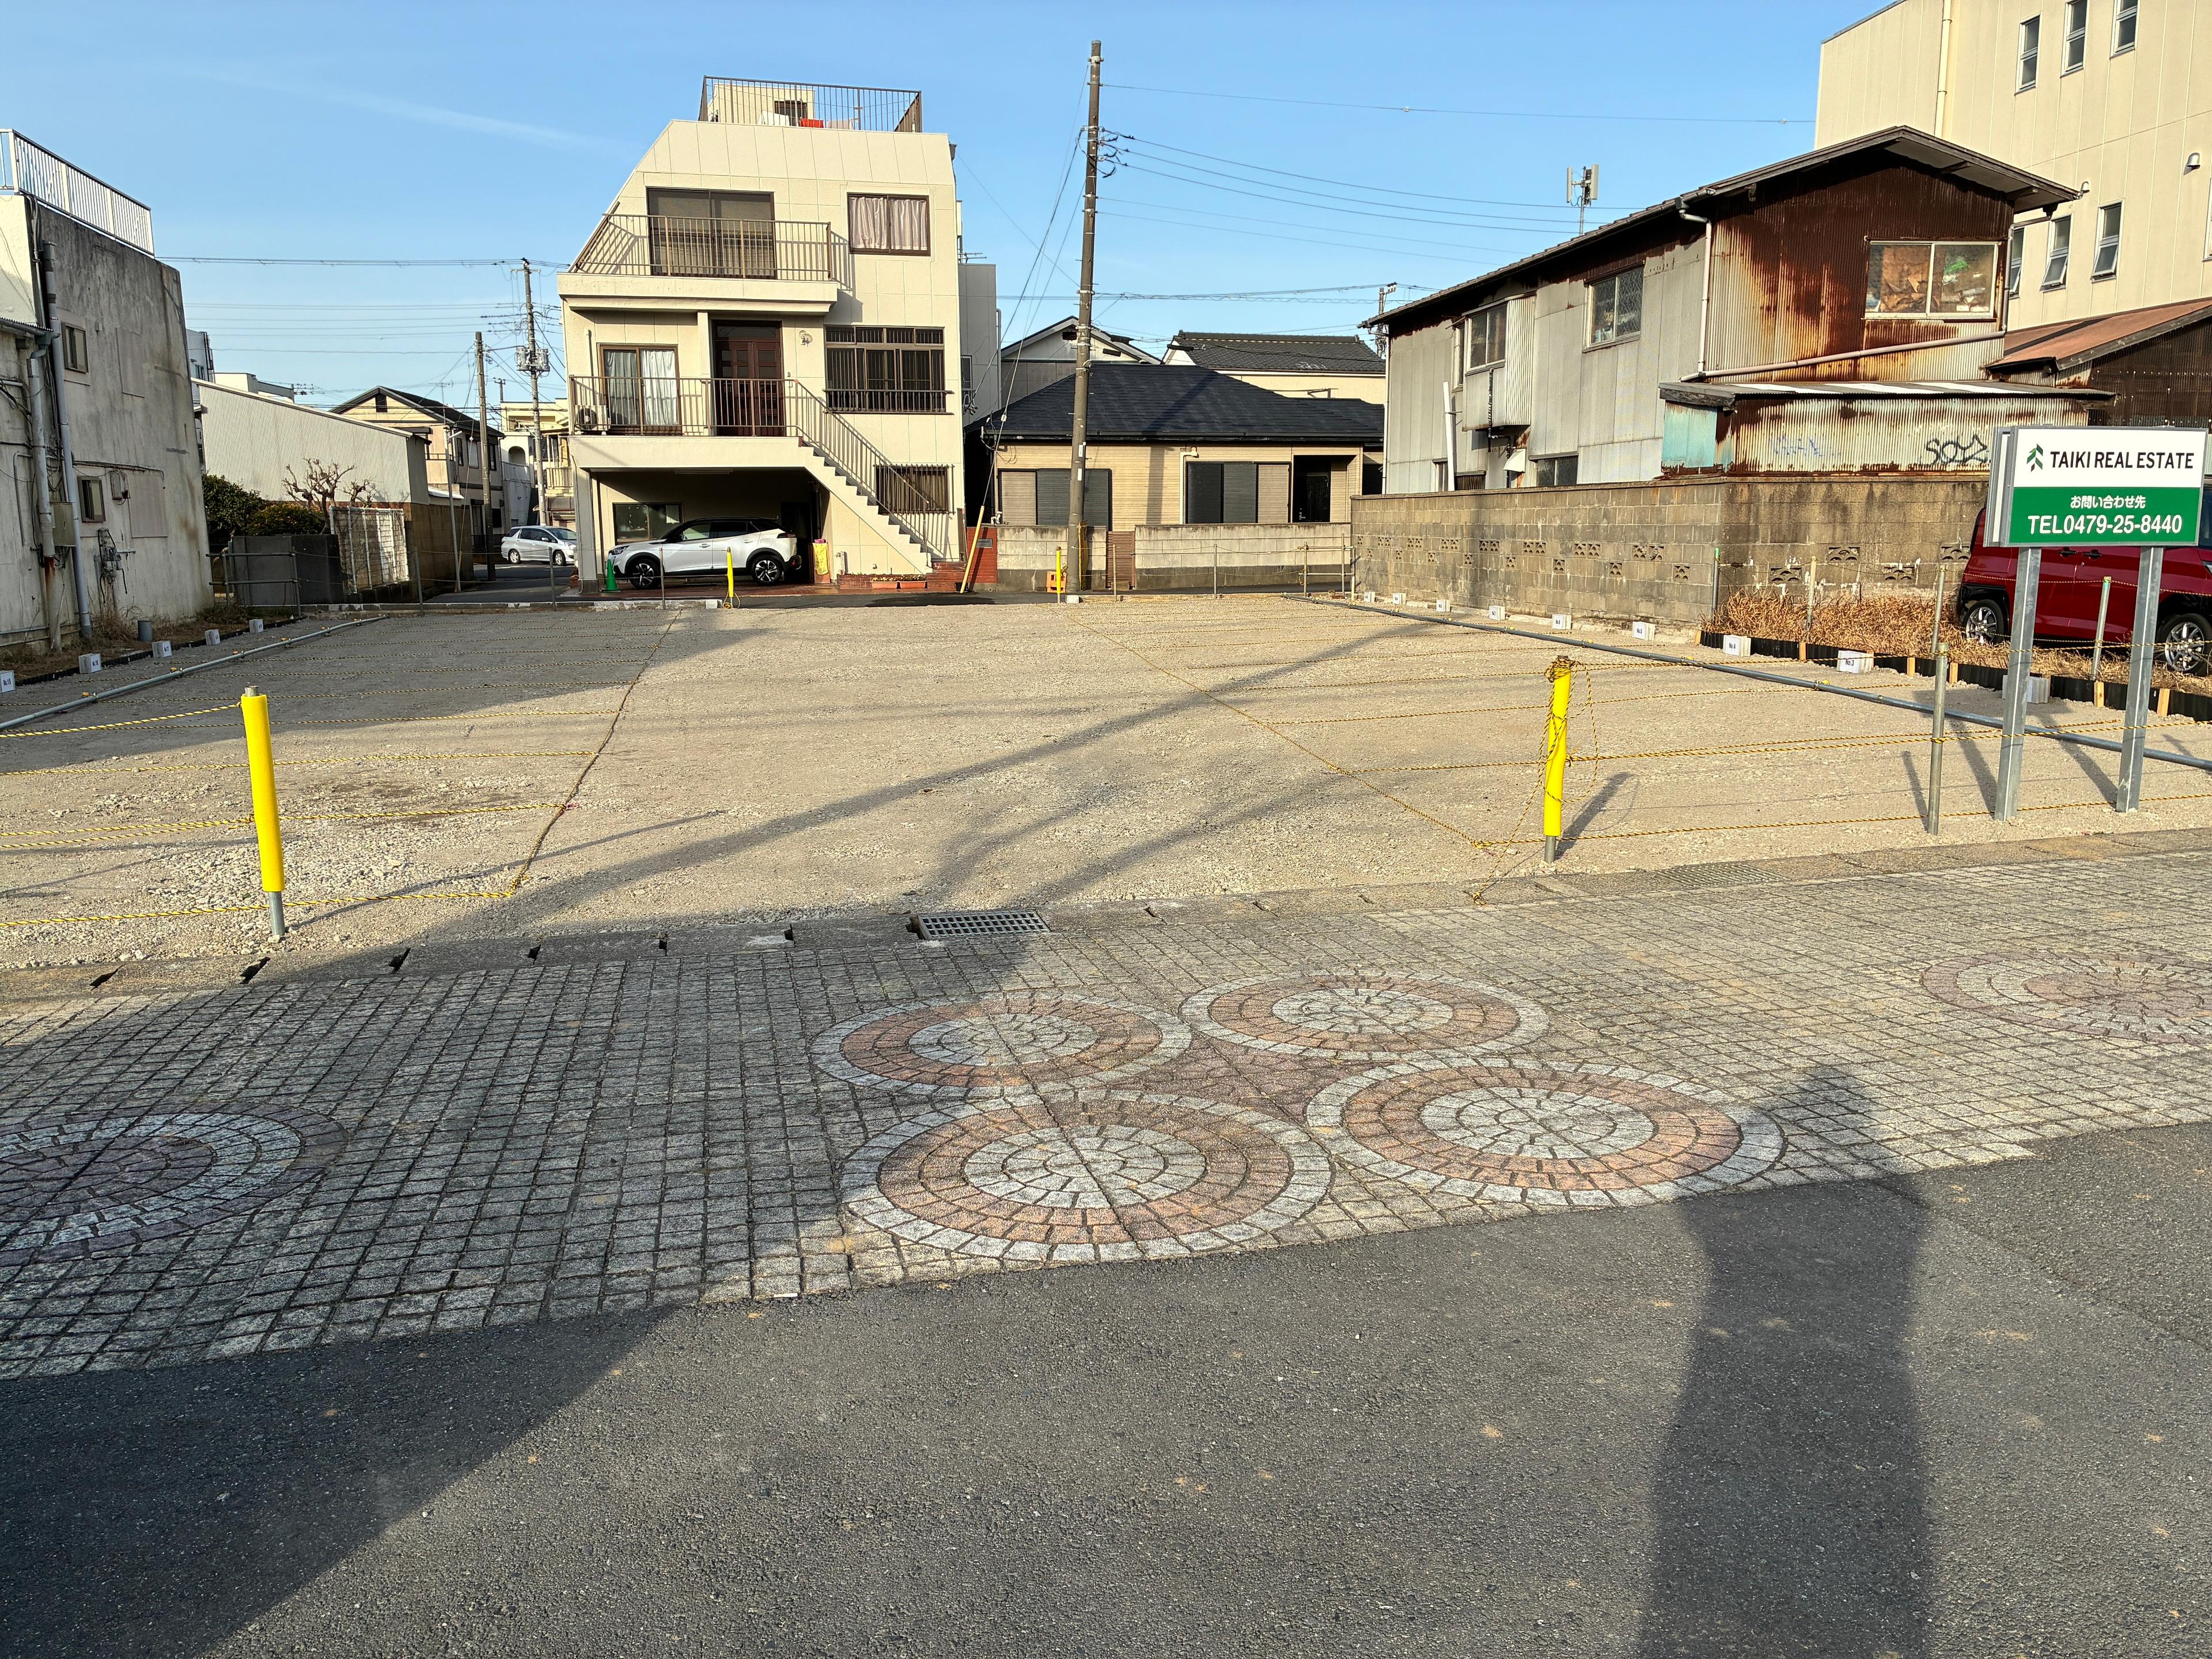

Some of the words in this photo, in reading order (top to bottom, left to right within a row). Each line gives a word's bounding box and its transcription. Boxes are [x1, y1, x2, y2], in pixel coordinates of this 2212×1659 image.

[2050, 451, 2091, 468] TAIKI
[2094, 452, 2133, 468] REAL
[2137, 452, 2194, 469] ESTATE
[2070, 495, 2146, 509] お問い合わせ先
[2027, 514, 2183, 535] TEL0479-25-8440
[1845, 658, 1854, 666] No.3
